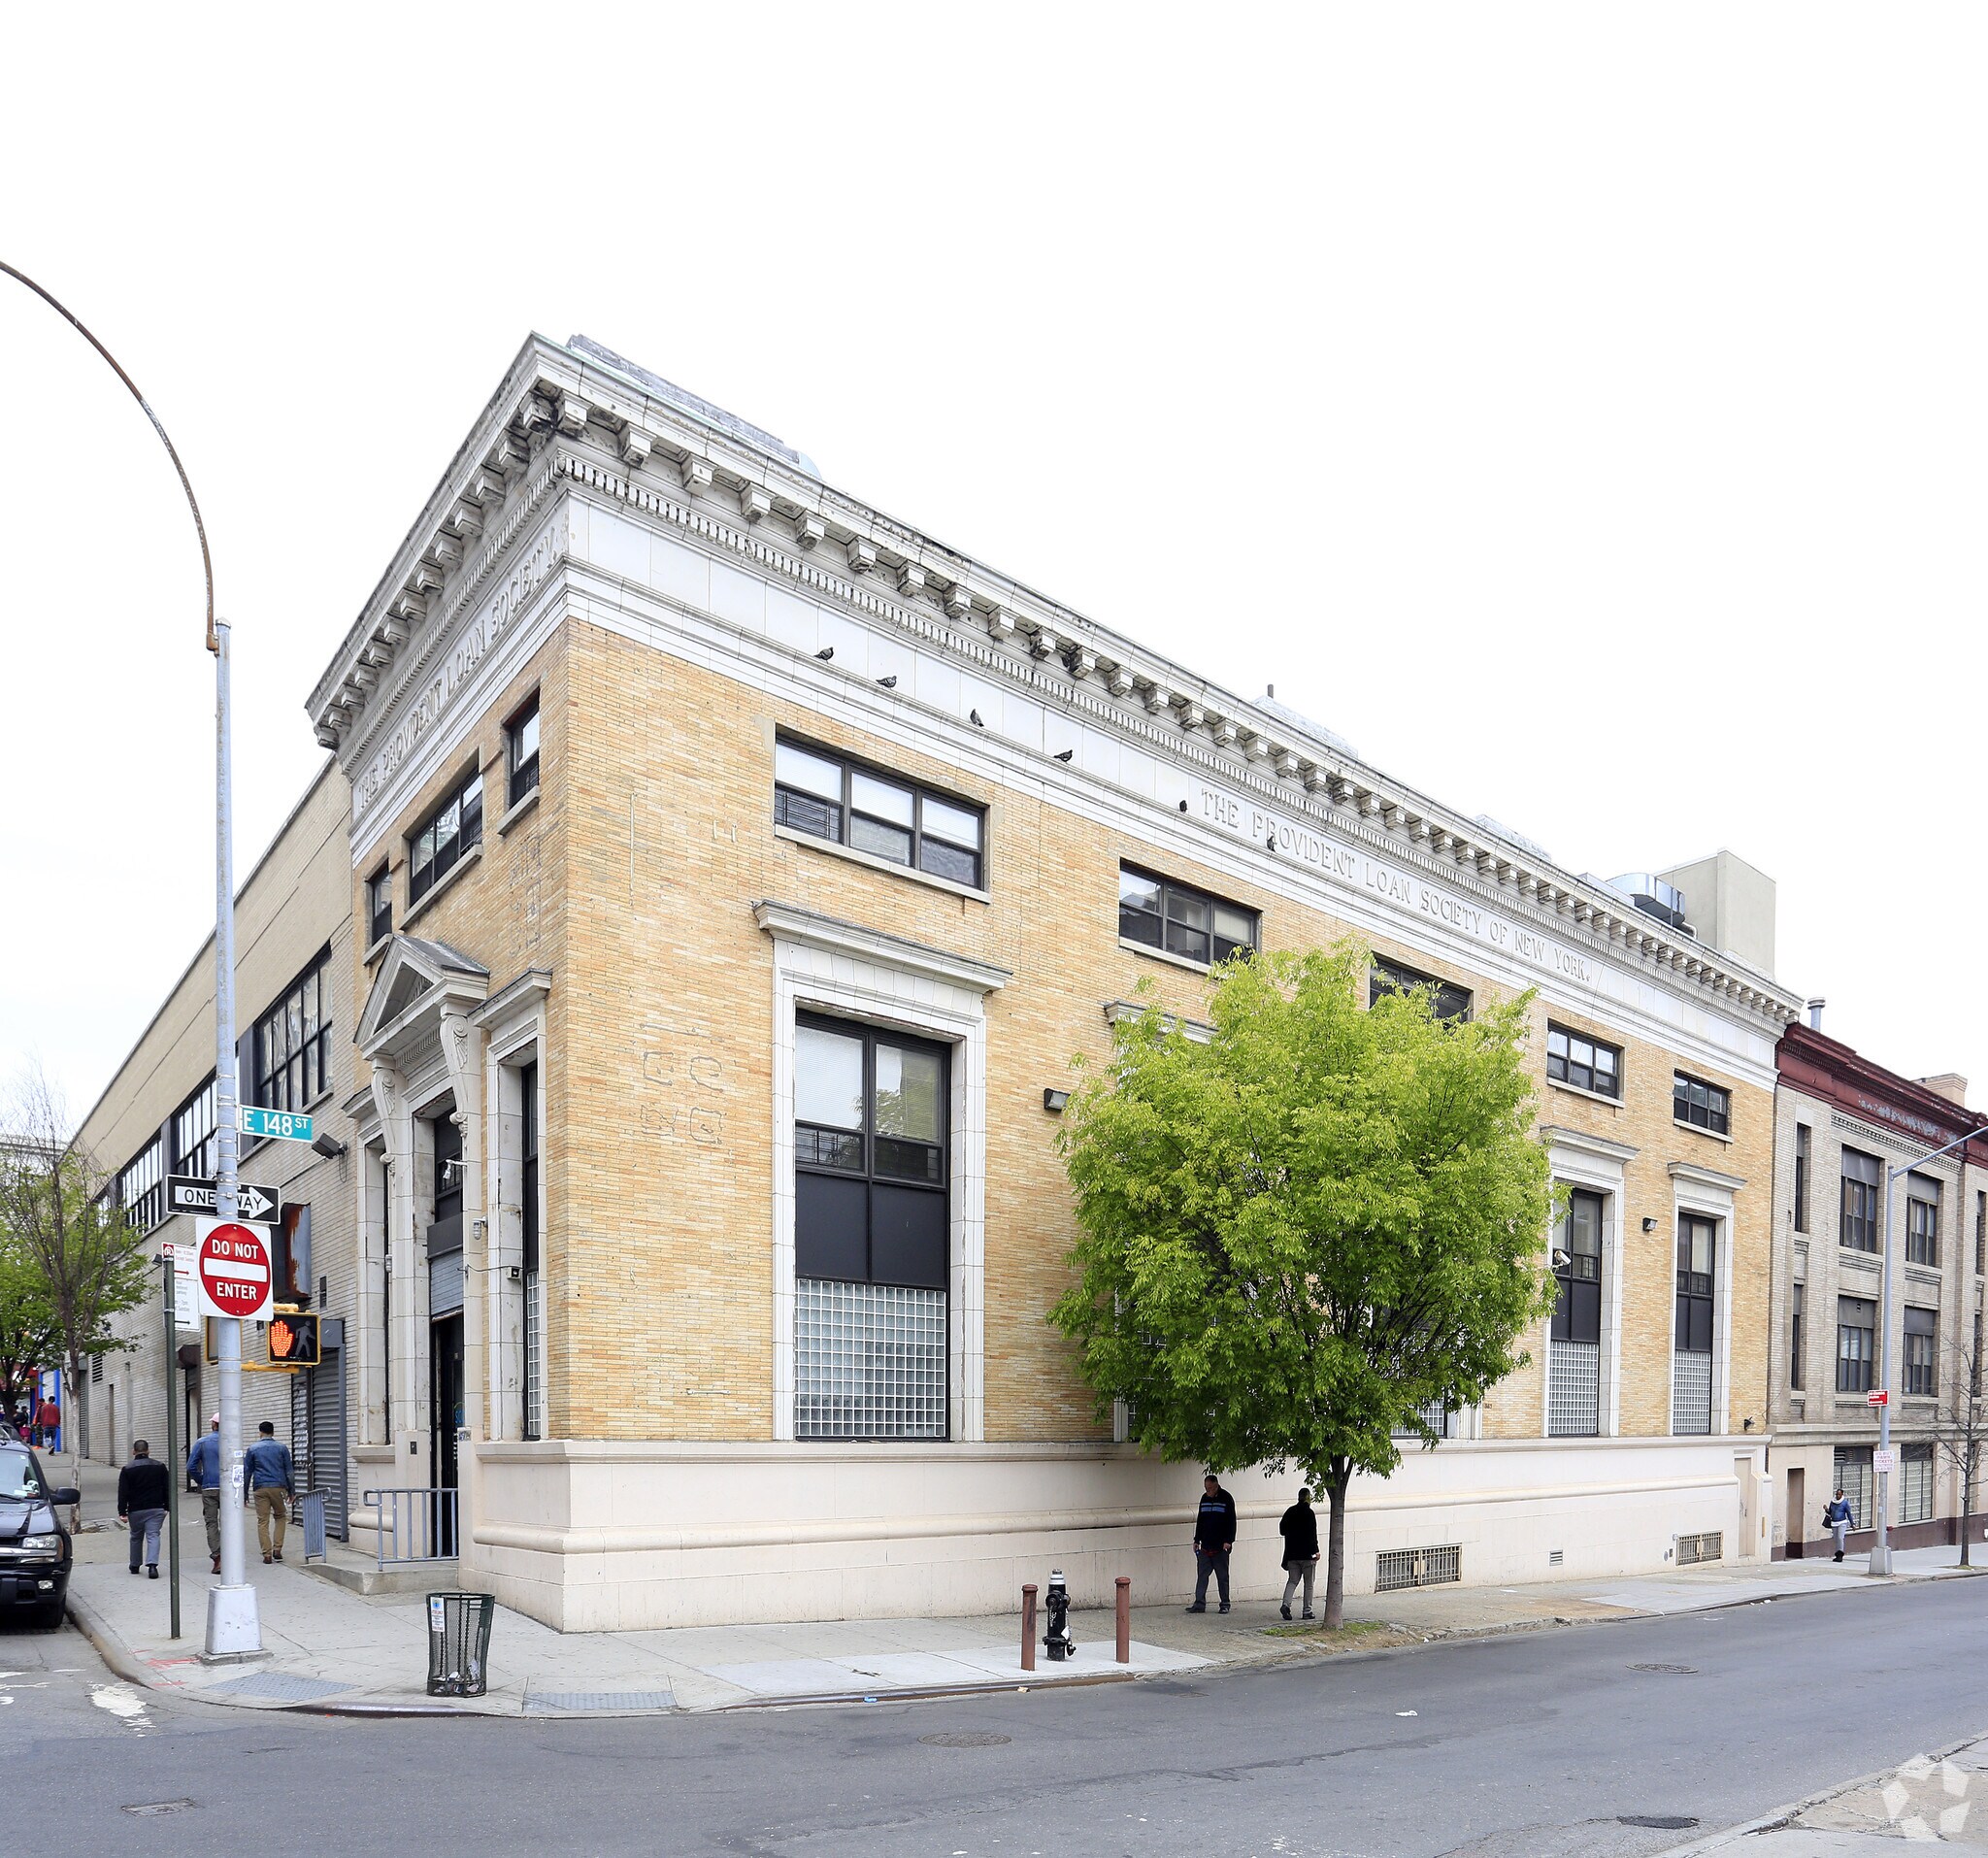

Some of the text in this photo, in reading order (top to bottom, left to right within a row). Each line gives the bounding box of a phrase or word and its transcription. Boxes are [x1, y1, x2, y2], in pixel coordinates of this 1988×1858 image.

[359, 764, 379, 809] THE
[383, 679, 442, 780] PROVIDENT
[447, 619, 486, 698] LOAN
[1202, 787, 1239, 828] THE
[1252, 811, 1355, 879] PROVIDENT
[1365, 862, 1410, 904] LOAN
[1420, 888, 1481, 934] SOCIETY
[1489, 919, 1508, 945] OF
[1515, 930, 1545, 961] NEW
[243, 1110, 309, 1137] E 148 ST
[184, 1189, 216, 1206] ONE
[212, 1239, 259, 1259] DO NOT
[216, 1281, 257, 1301] ENTER
